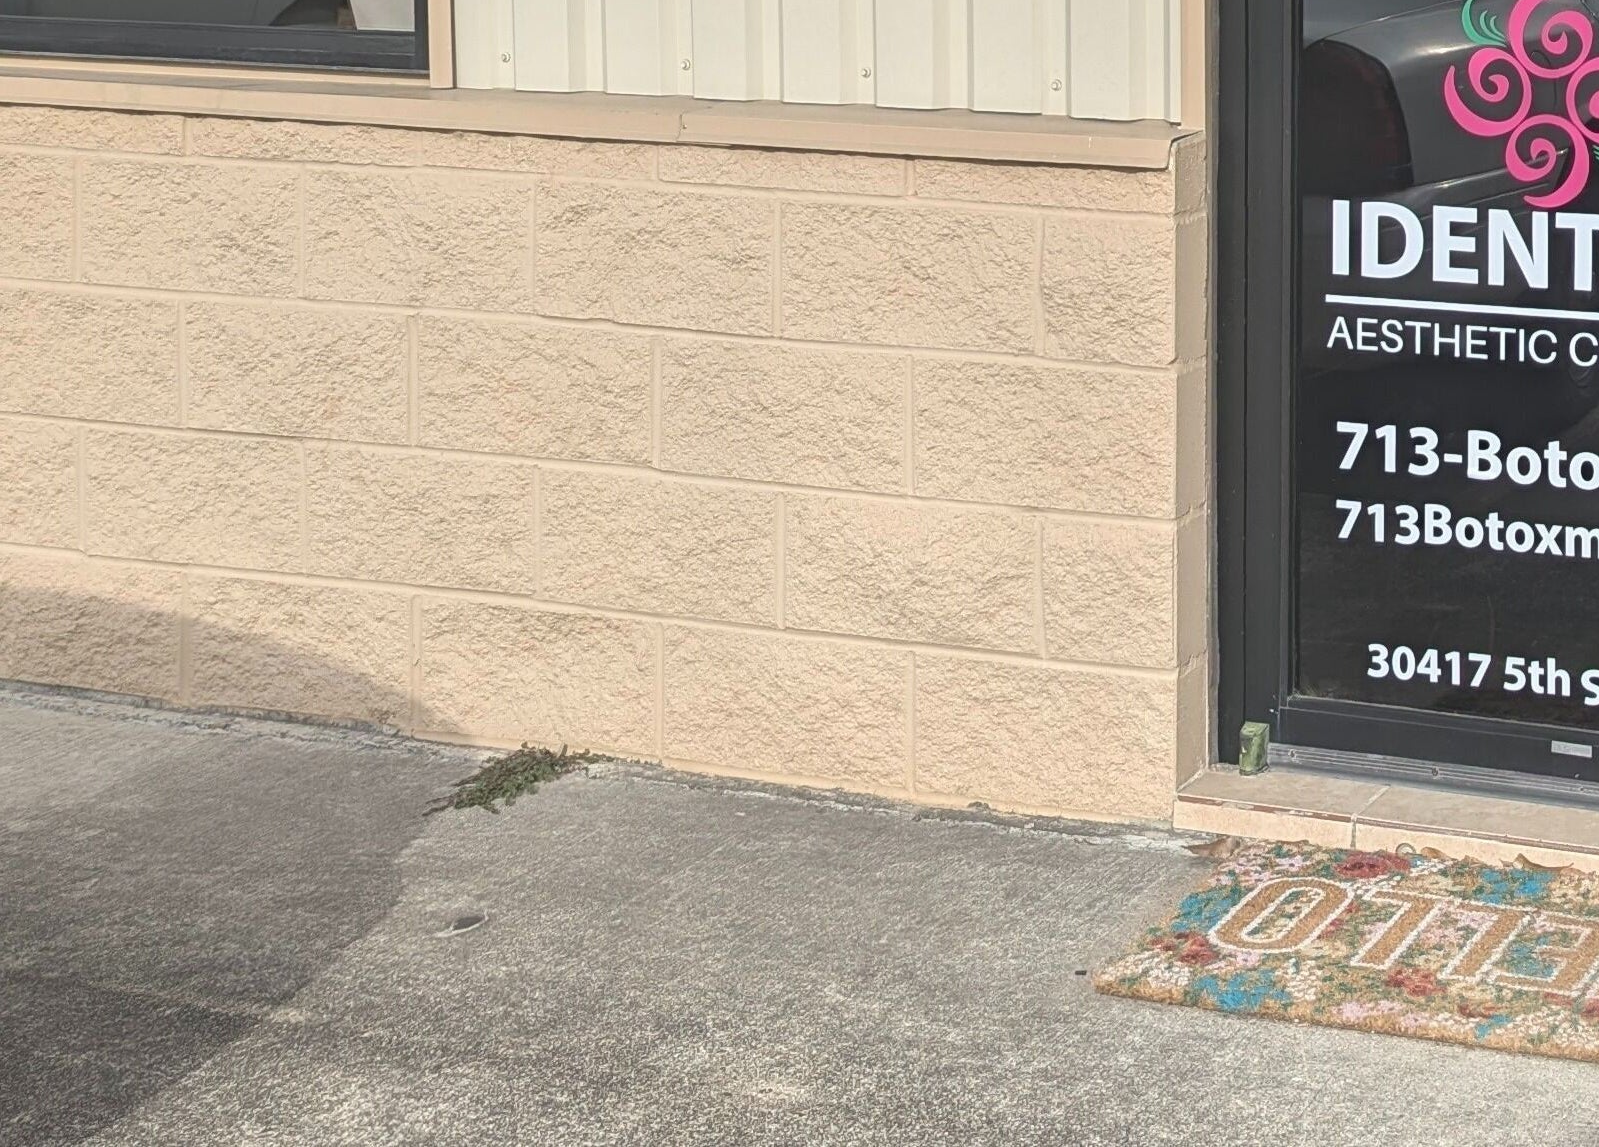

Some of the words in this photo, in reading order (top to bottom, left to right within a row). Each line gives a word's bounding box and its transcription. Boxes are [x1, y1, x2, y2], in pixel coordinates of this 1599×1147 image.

[1326, 315, 1558, 365] AESTHETIC
[1366, 643, 1491, 688] 30417
[1503, 656, 1571, 697] 5th
